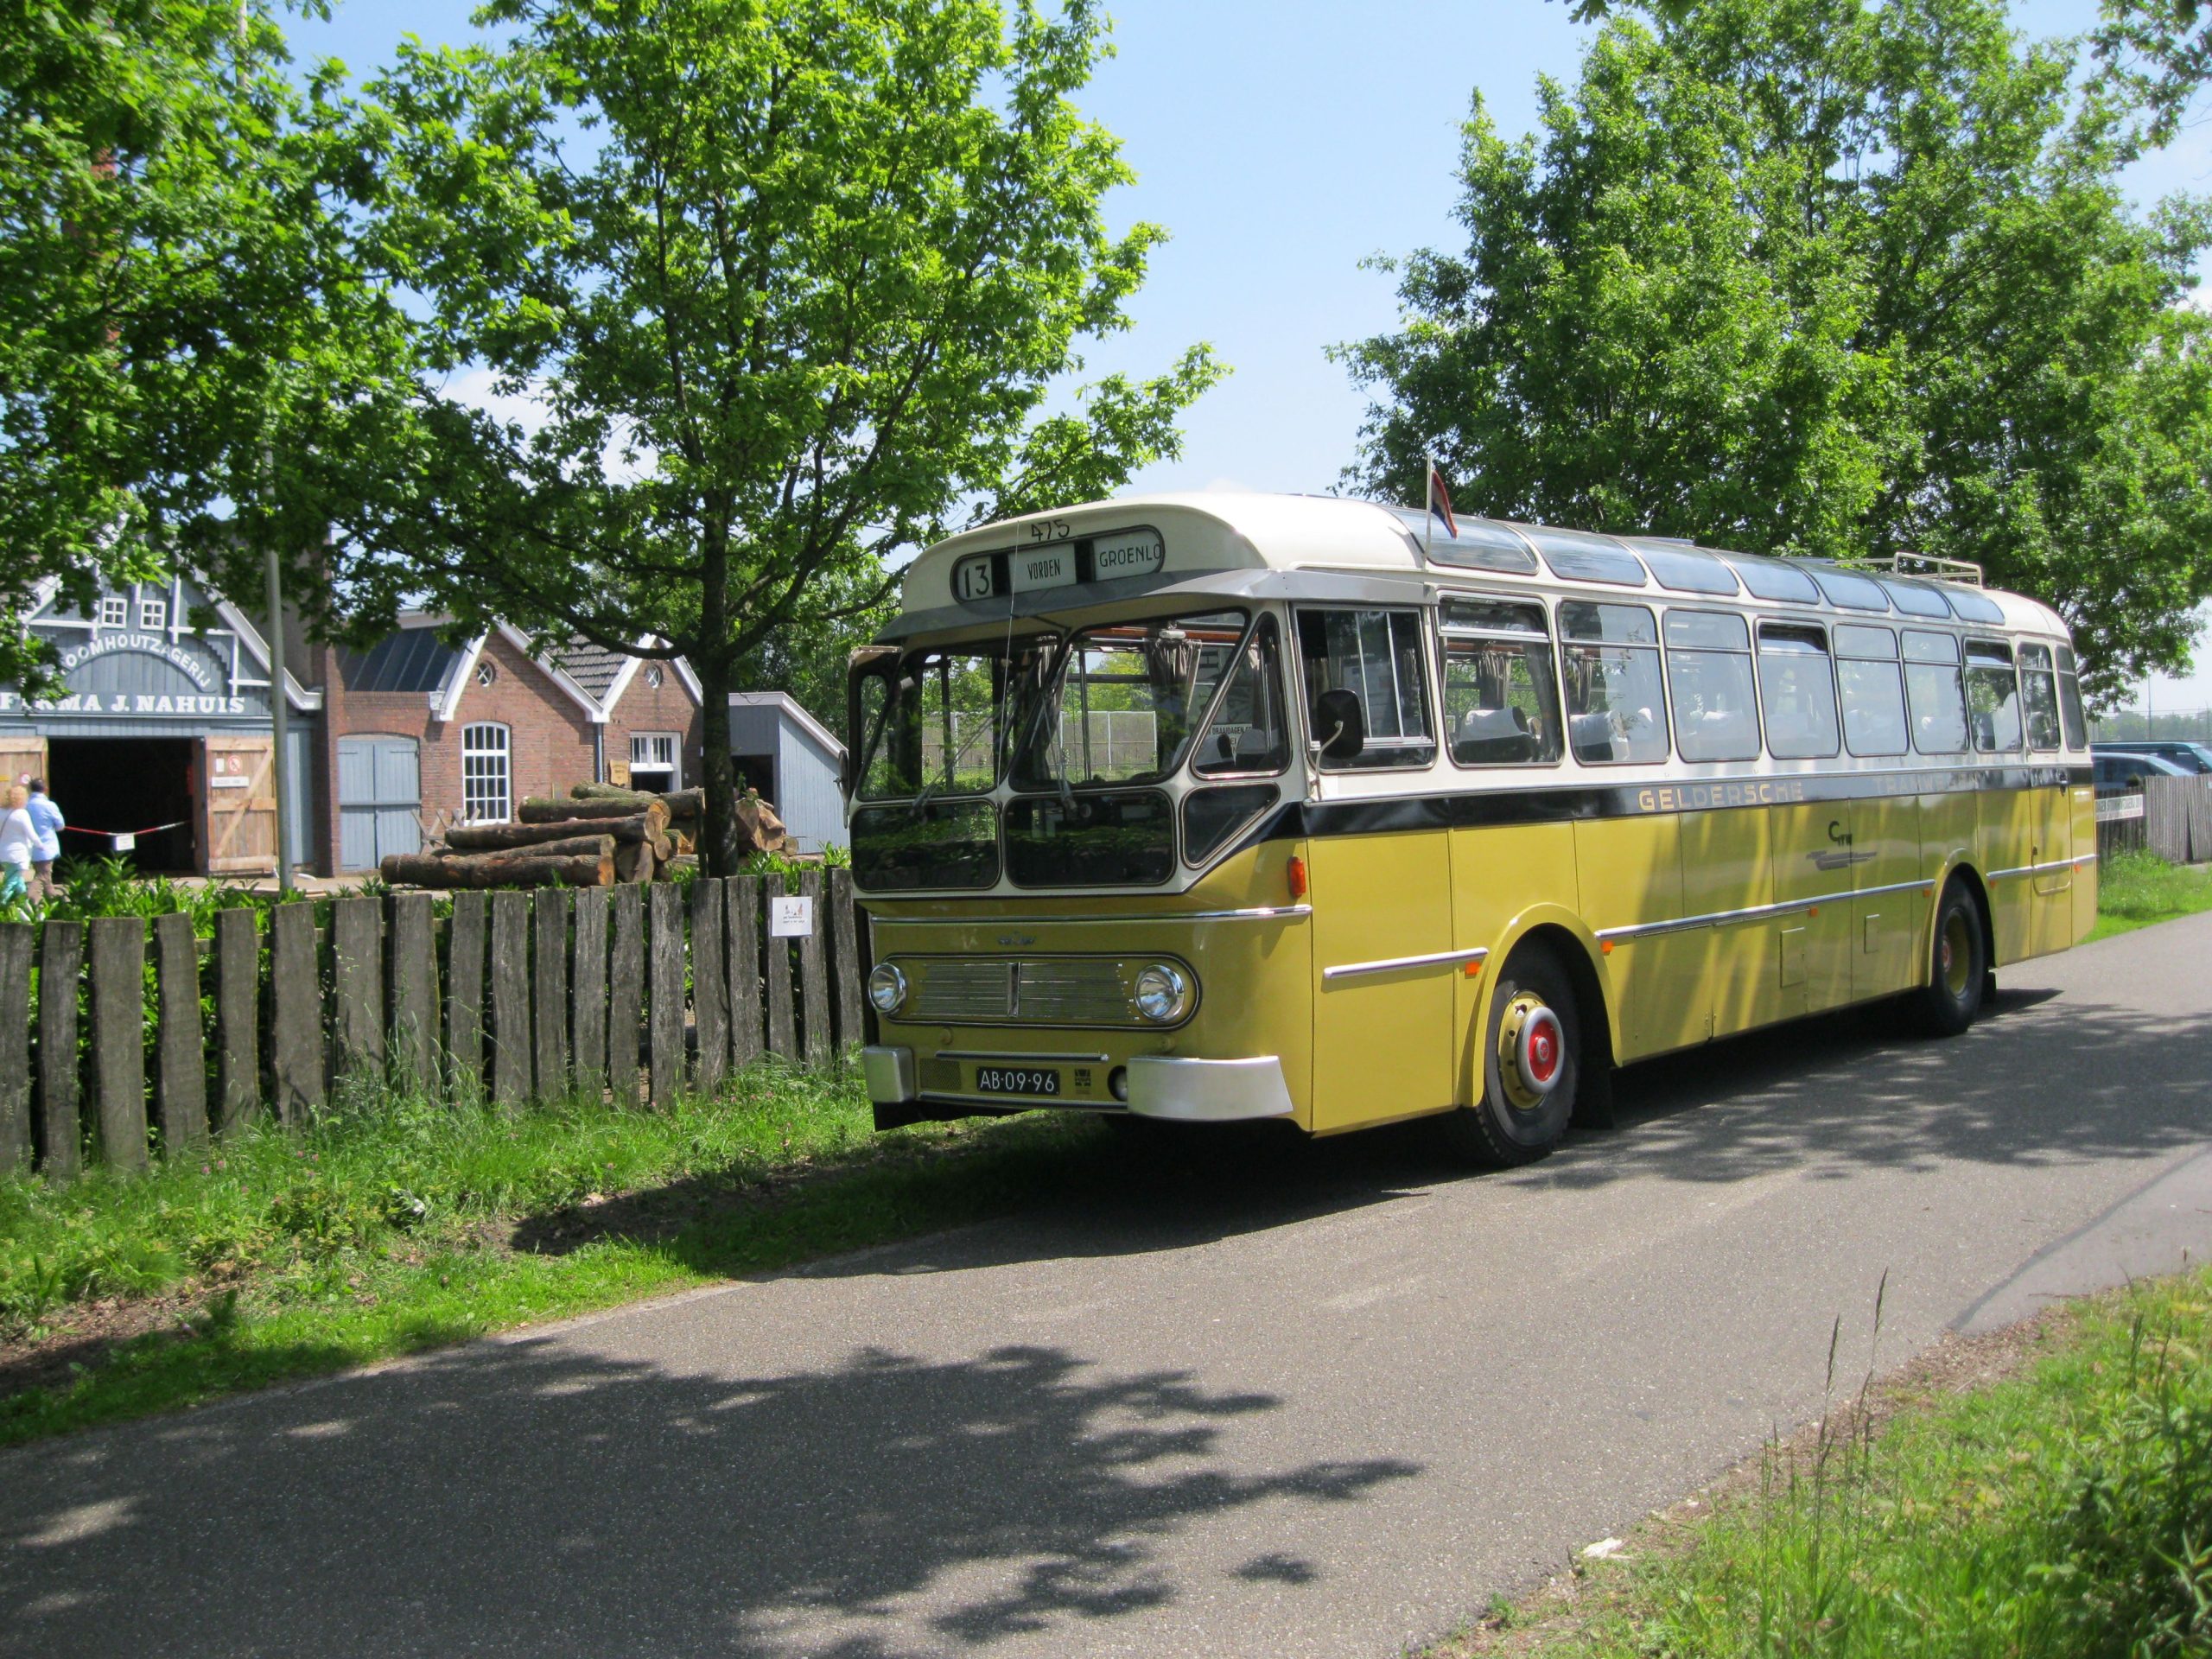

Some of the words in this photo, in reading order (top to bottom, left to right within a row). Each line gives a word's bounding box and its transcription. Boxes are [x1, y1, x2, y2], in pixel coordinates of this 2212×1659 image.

[1031, 519, 1070, 541] 475
[1099, 543, 1161, 567] GROENLO
[964, 564, 989, 597] 13
[1027, 559, 1060, 580] VORDEN
[137, 695, 245, 714] NAHUIS
[1638, 782, 1804, 810] GELDERSCHE
